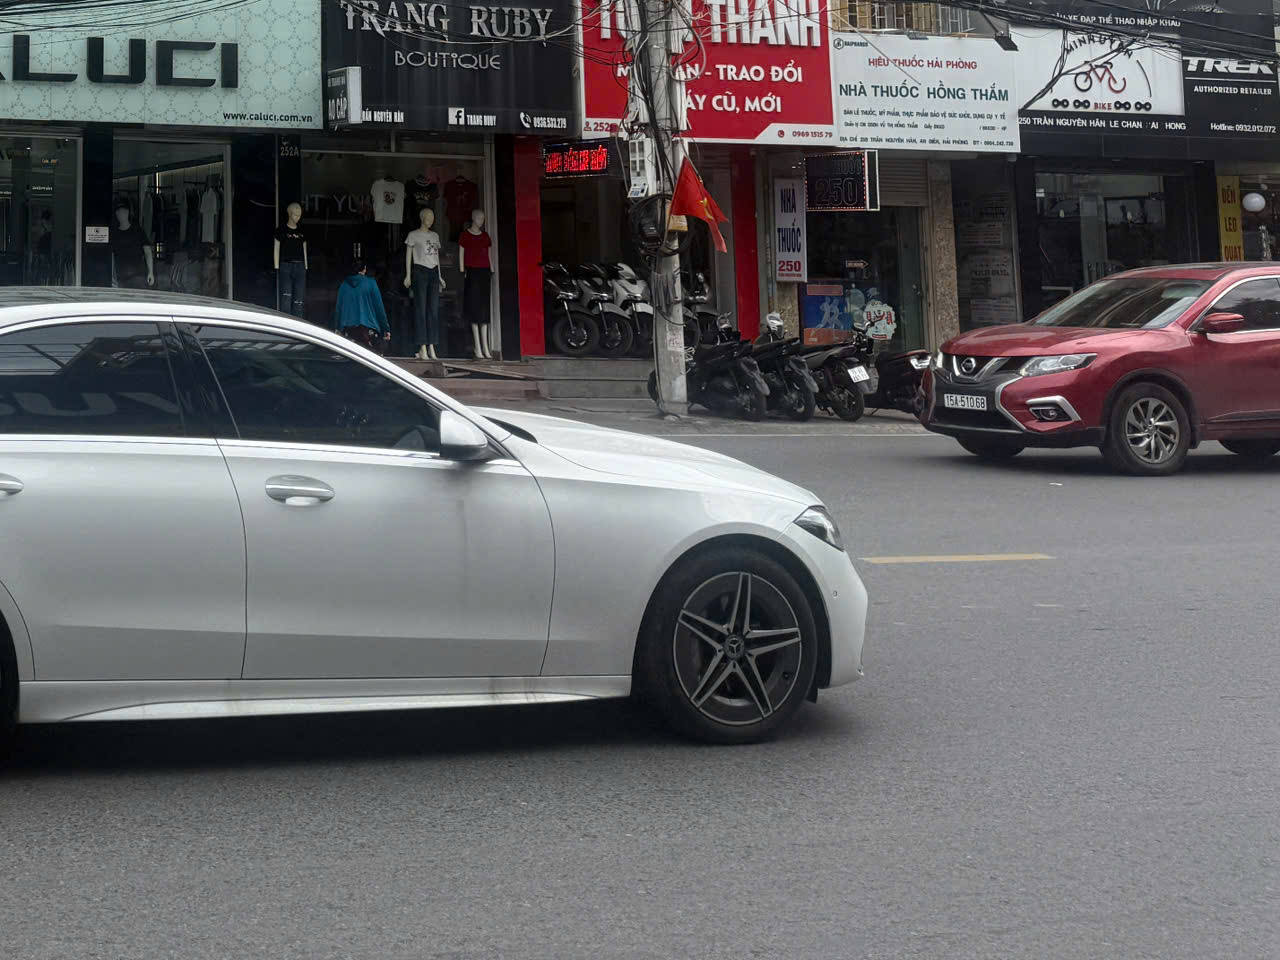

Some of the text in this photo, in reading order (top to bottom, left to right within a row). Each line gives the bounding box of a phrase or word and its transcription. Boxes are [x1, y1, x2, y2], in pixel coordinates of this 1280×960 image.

[340, 0, 554, 47] TRANG RUBY
[715, 60, 803, 83] TRAO ĐỔI
[945, 57, 977, 70] PHÒNG
[1182, 57, 1273, 75] TREK
[839, 79, 1009, 102] NHÀ THUỐC HỒNG THẮM
[1194, 86, 1272, 96] AUTHORIZED RETAILER
[744, 92, 782, 112] MỚI
[1094, 102, 1112, 110] BIKE
[222, 109, 313, 125] www.caluci.com.vn
[1019, 117, 1031, 125] 250
[1056, 117, 1087, 128] NGUYÊN
[792, 130, 810, 138] 0969
[780, 184, 796, 213] NHÀ
[815, 177, 858, 207] 250
[777, 219, 801, 253] THUỐC
[778, 260, 801, 272] 250
